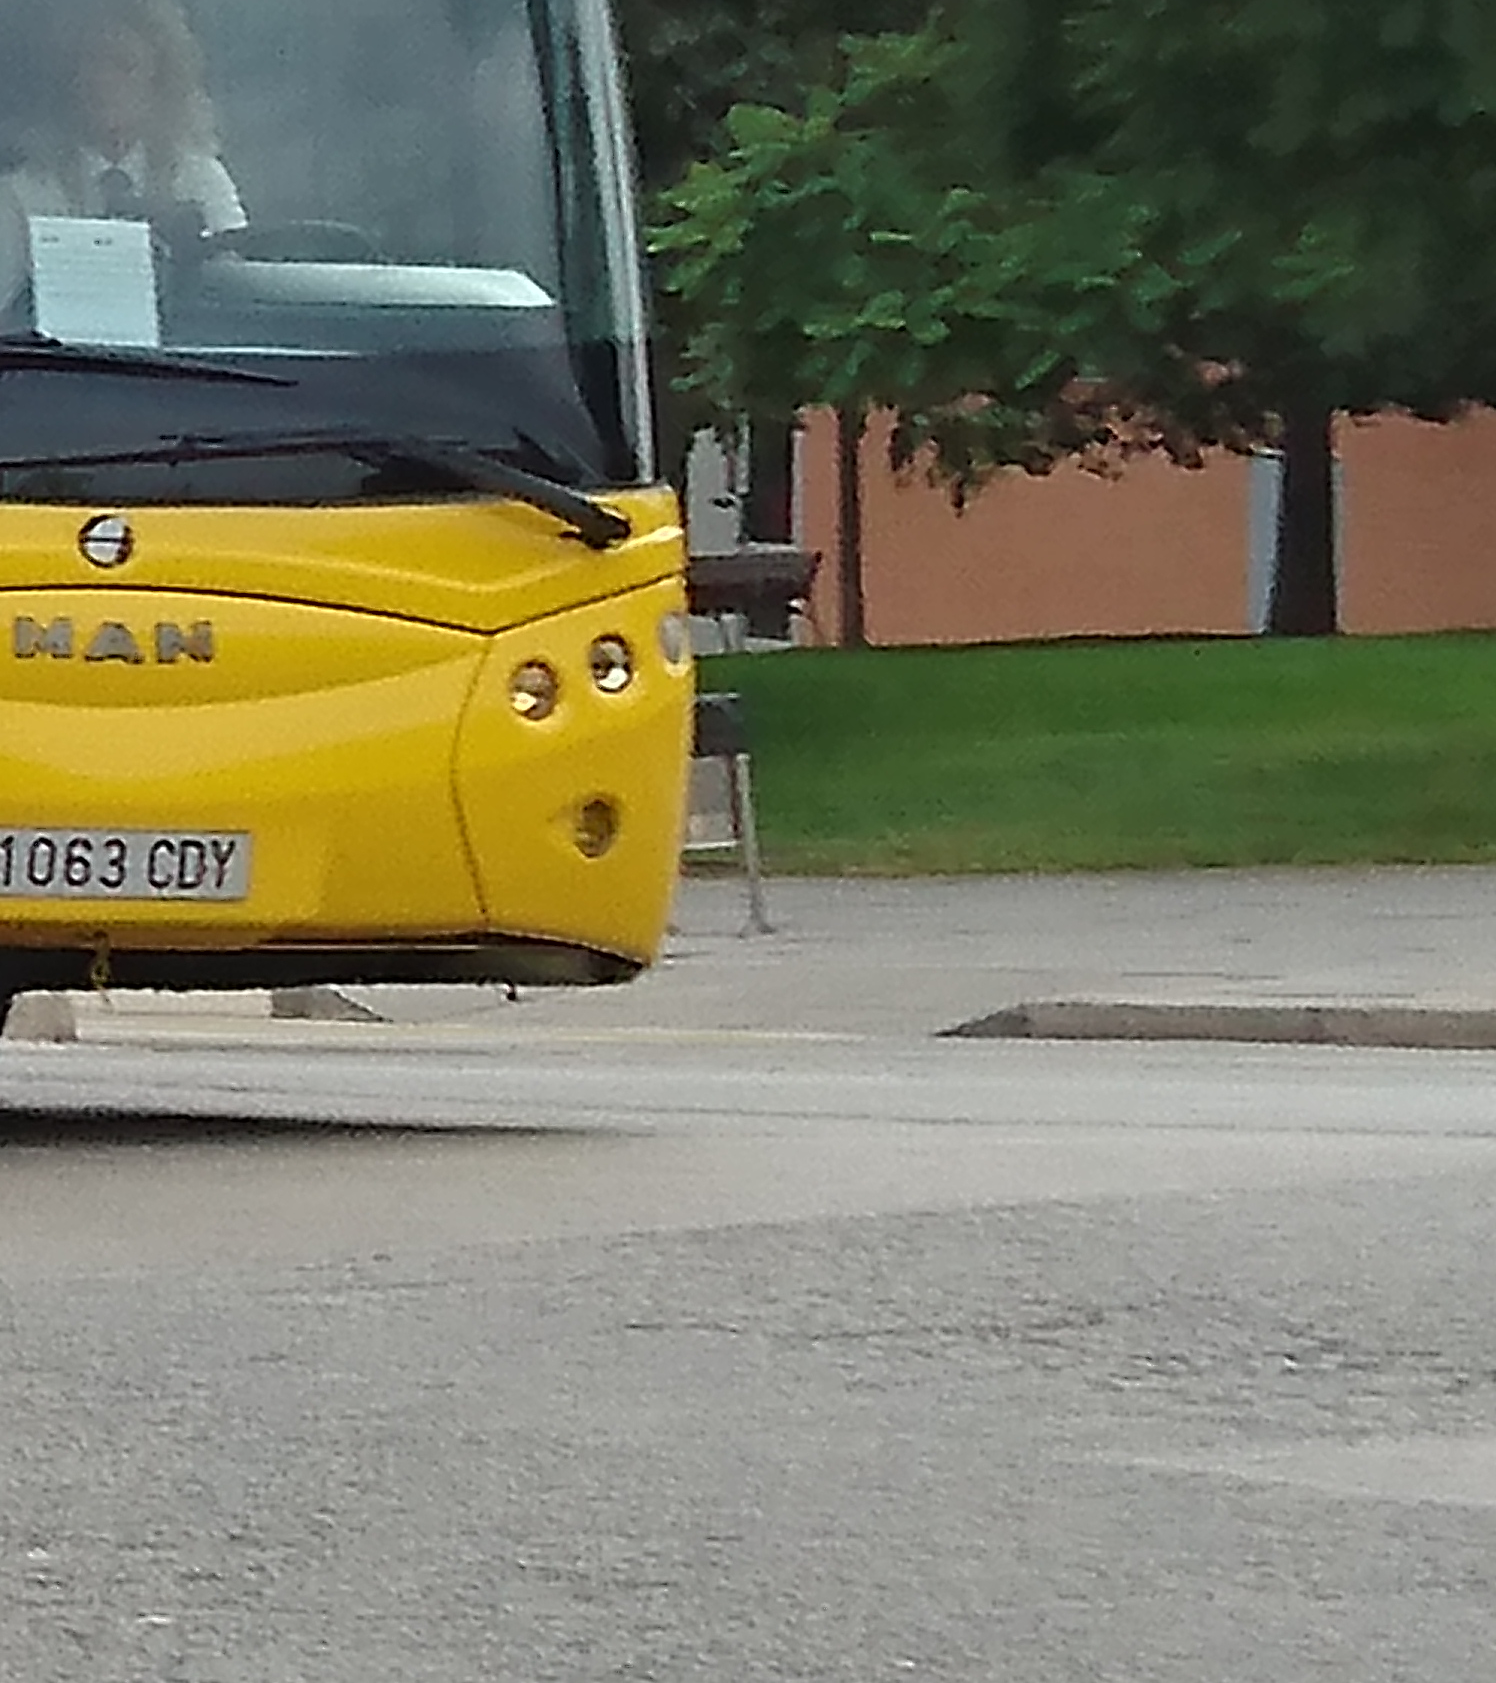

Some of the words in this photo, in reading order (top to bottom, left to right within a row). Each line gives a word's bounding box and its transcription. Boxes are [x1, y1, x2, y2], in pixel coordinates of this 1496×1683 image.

[13, 616, 214, 664] MAN
[0, 835, 128, 889] 1063
[147, 838, 236, 890] CDY
